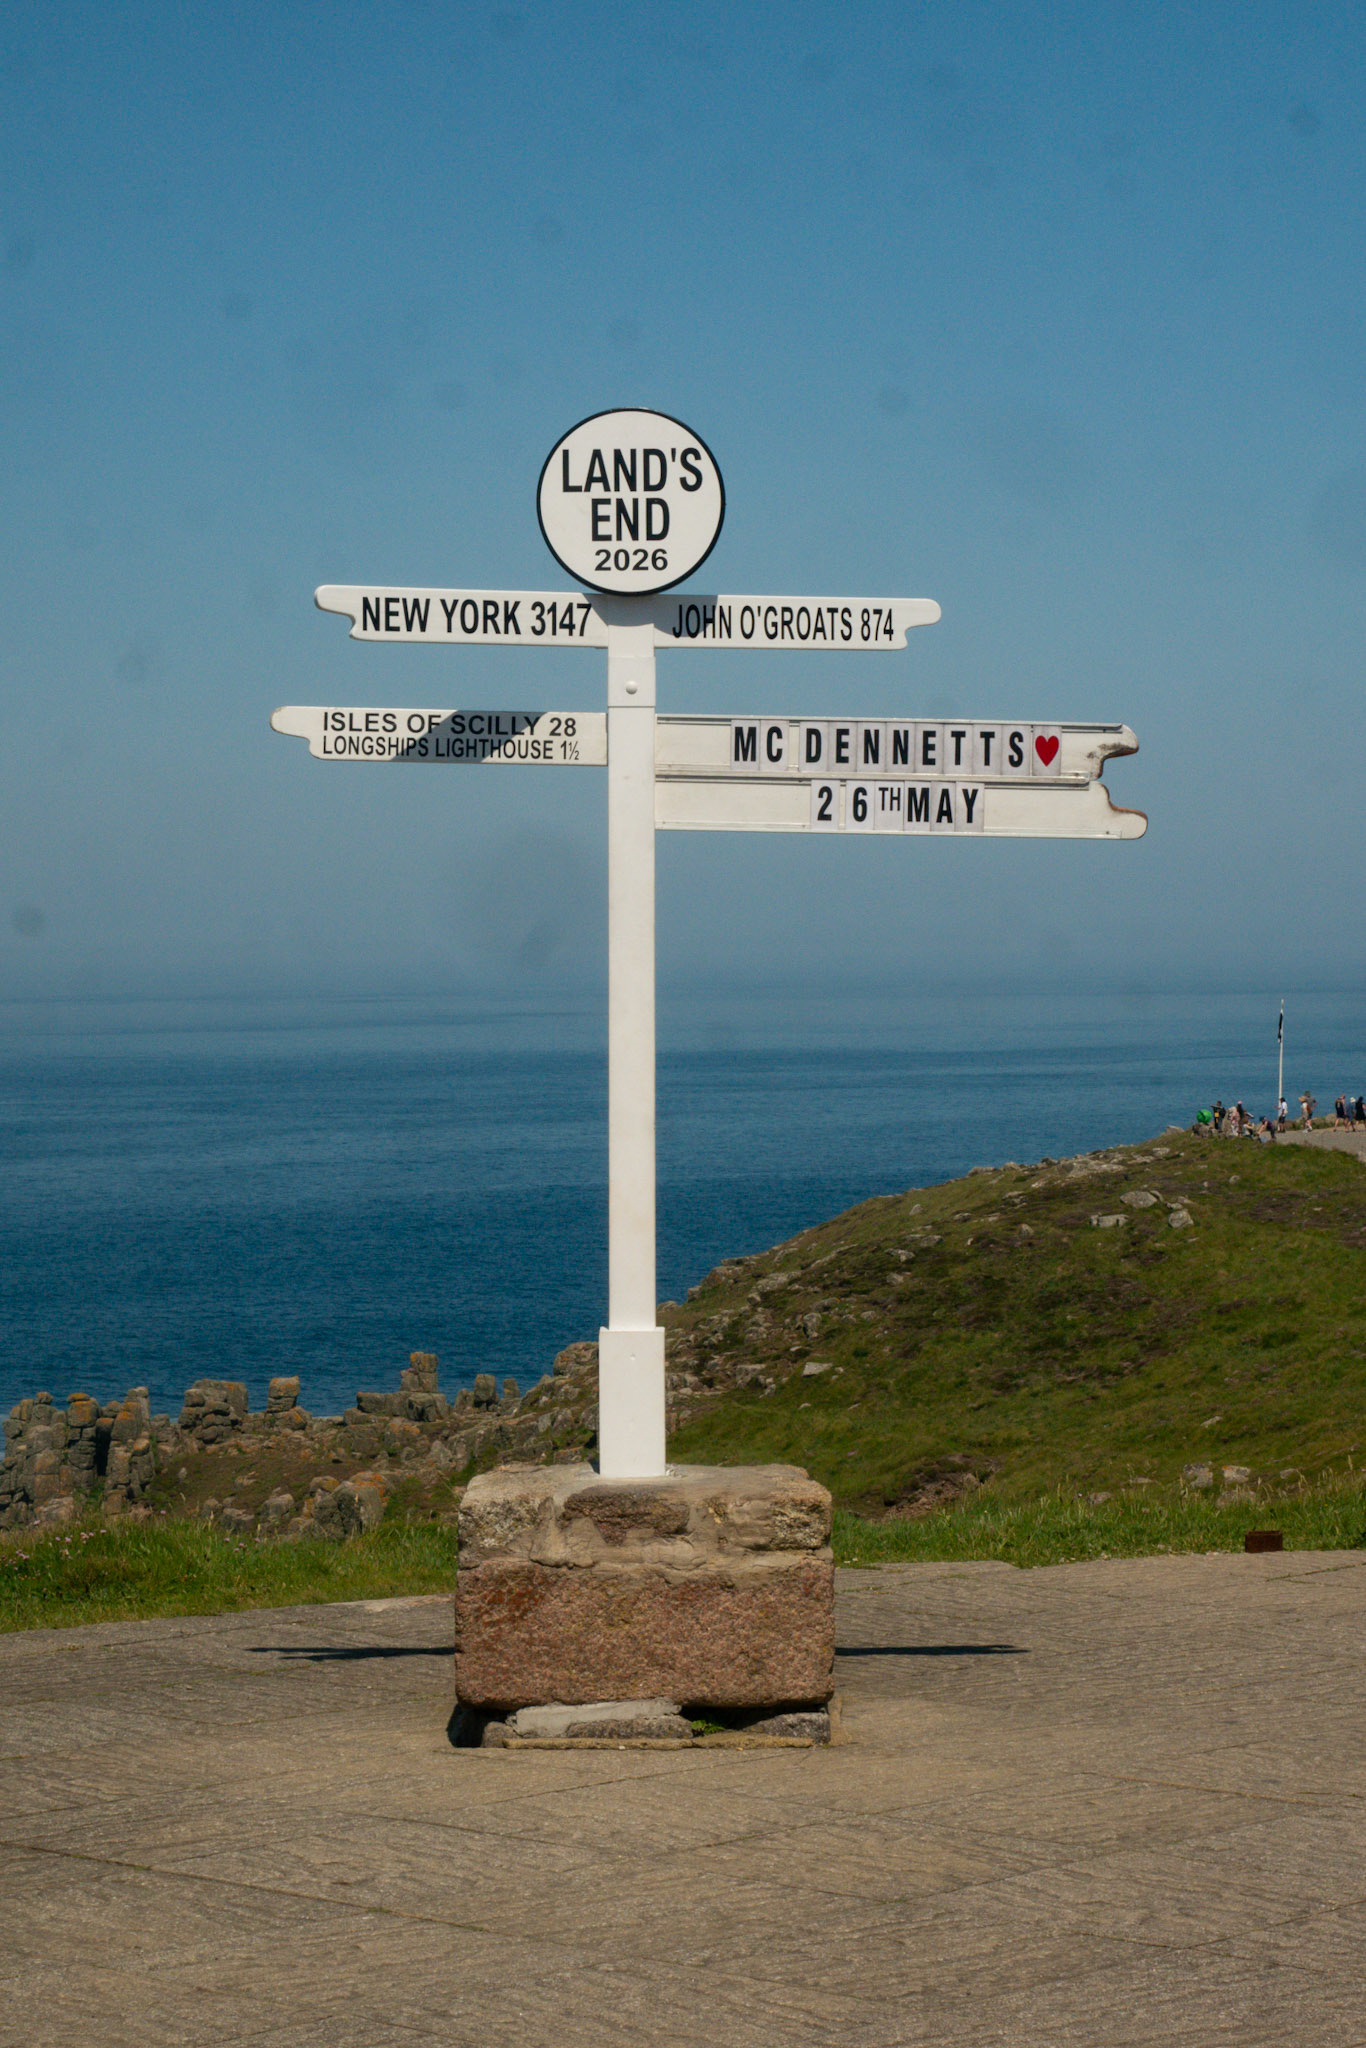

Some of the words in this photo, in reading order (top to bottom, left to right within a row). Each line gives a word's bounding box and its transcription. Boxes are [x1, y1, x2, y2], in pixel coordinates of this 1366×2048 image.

[562, 448, 703, 493] LAND'S
[591, 497, 668, 541] END
[594, 547, 667, 571] 2026
[362, 596, 431, 633] NEW
[440, 599, 522, 635] YORK
[530, 601, 592, 637] 3147
[672, 604, 732, 639] JOHN
[740, 605, 853, 641] O'GROATS
[860, 608, 894, 642] 874
[323, 711, 398, 733] ISLES
[406, 714, 442, 734] OF
[450, 715, 540, 736] SCILLY
[549, 717, 577, 737] 28
[322, 735, 429, 758] LONGSHIPS
[435, 738, 553, 760] LIGHTHOUSE
[907, 787, 979, 823] MAY
